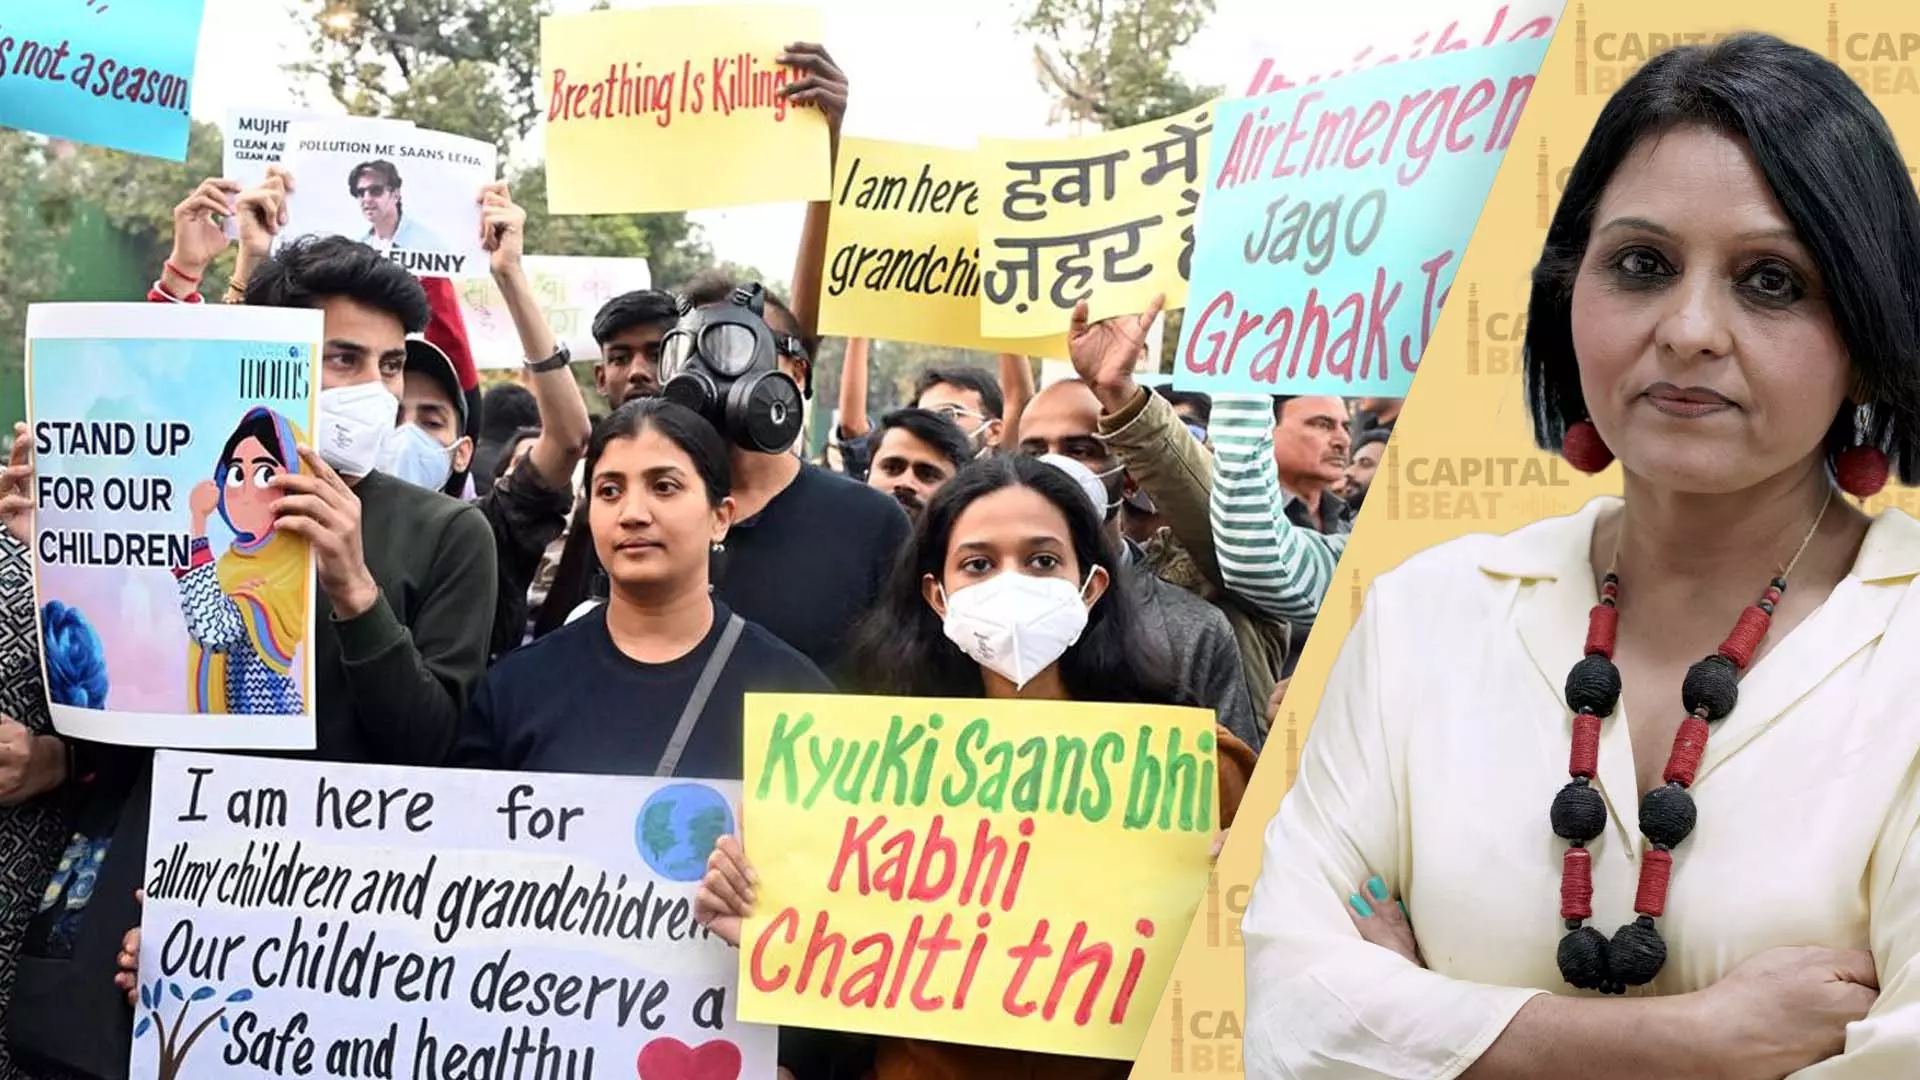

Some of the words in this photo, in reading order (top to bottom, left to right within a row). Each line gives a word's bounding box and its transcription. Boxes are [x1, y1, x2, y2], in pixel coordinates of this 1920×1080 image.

[12, 40, 69, 80] not
[71, 53, 95, 90] a
[548, 62, 675, 128] Breathing
[680, 60, 704, 113] Is
[233, 138, 267, 150] CLEAN
[271, 141, 286, 152] AI
[235, 150, 263, 161] CLEAN
[299, 139, 371, 154] POLLUTION
[375, 143, 396, 157] ME
[400, 146, 445, 161] SAANS
[1002, 150, 1130, 221] हवा
[1141, 112, 1213, 184] में
[839, 157, 861, 206] I
[855, 175, 908, 211] am
[908, 163, 979, 215] here
[984, 215, 1163, 313] ज़हर
[1243, 189, 1387, 276] Jago
[35, 421, 136, 456] STAND
[145, 423, 191, 456] UP
[38, 476, 94, 510] FOR
[103, 477, 172, 511] OUR
[39, 530, 190, 567] CHILDREN
[178, 767, 214, 823] I
[226, 788, 288, 828] am
[315, 777, 434, 832] here
[497, 782, 585, 842] for
[1122, 725, 1214, 832] bhi
[216, 840, 353, 910] children
[351, 854, 437, 920] and
[827, 814, 1036, 911] Kabhi
[160, 918, 251, 982] Our
[251, 919, 456, 1004] children
[470, 949, 668, 1030] deserve
[693, 984, 725, 1029] a
[750, 907, 990, 1012] Chalti
[1000, 917, 1155, 1026] thi
[325, 1021, 400, 1080] and
[411, 1017, 596, 1080] healthy
